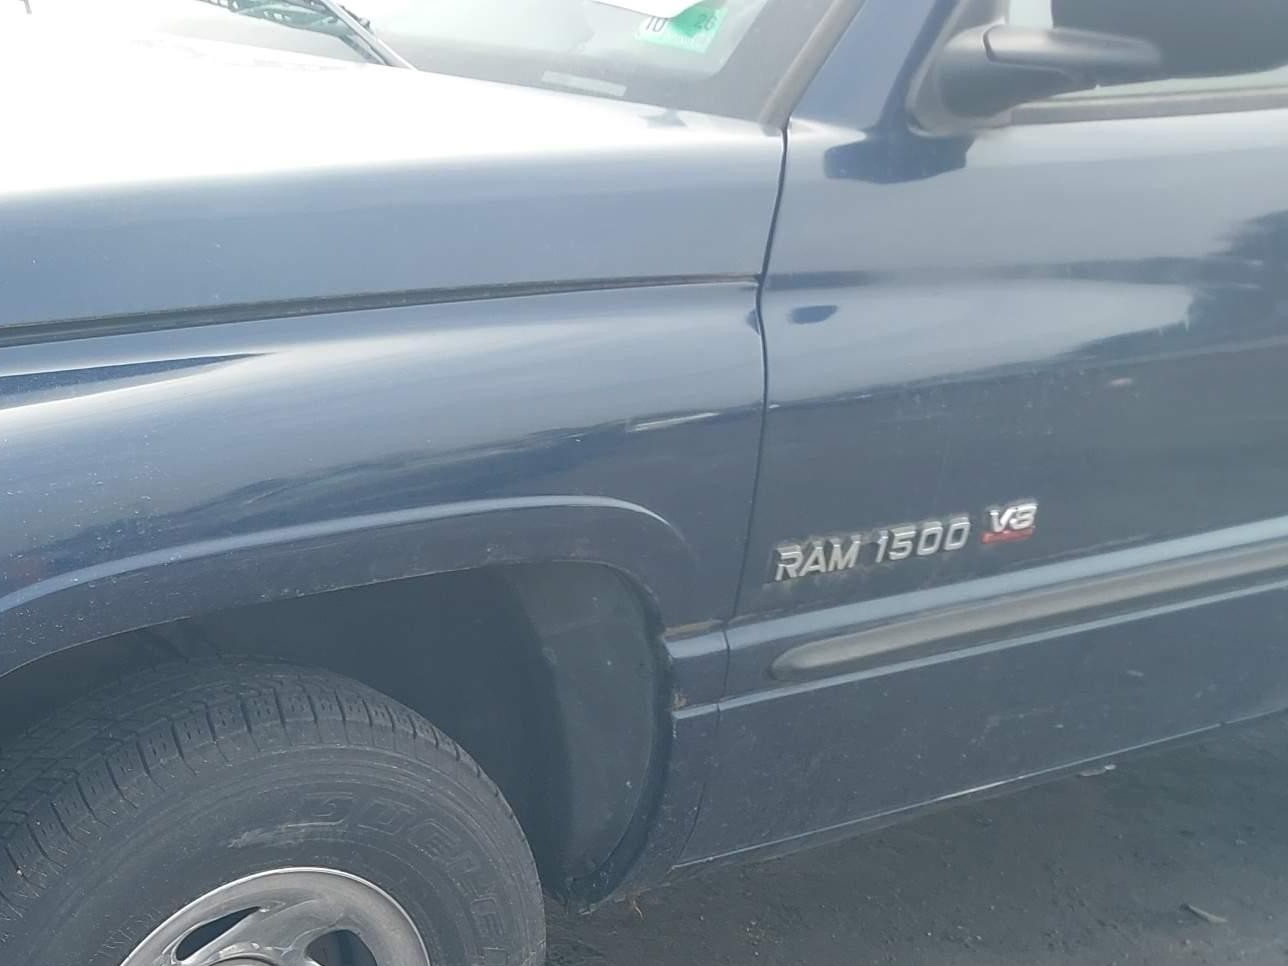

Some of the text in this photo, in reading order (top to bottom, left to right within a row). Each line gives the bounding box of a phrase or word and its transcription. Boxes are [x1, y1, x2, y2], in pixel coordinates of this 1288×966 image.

[774, 499, 1038, 581] RAM 1500 V8
